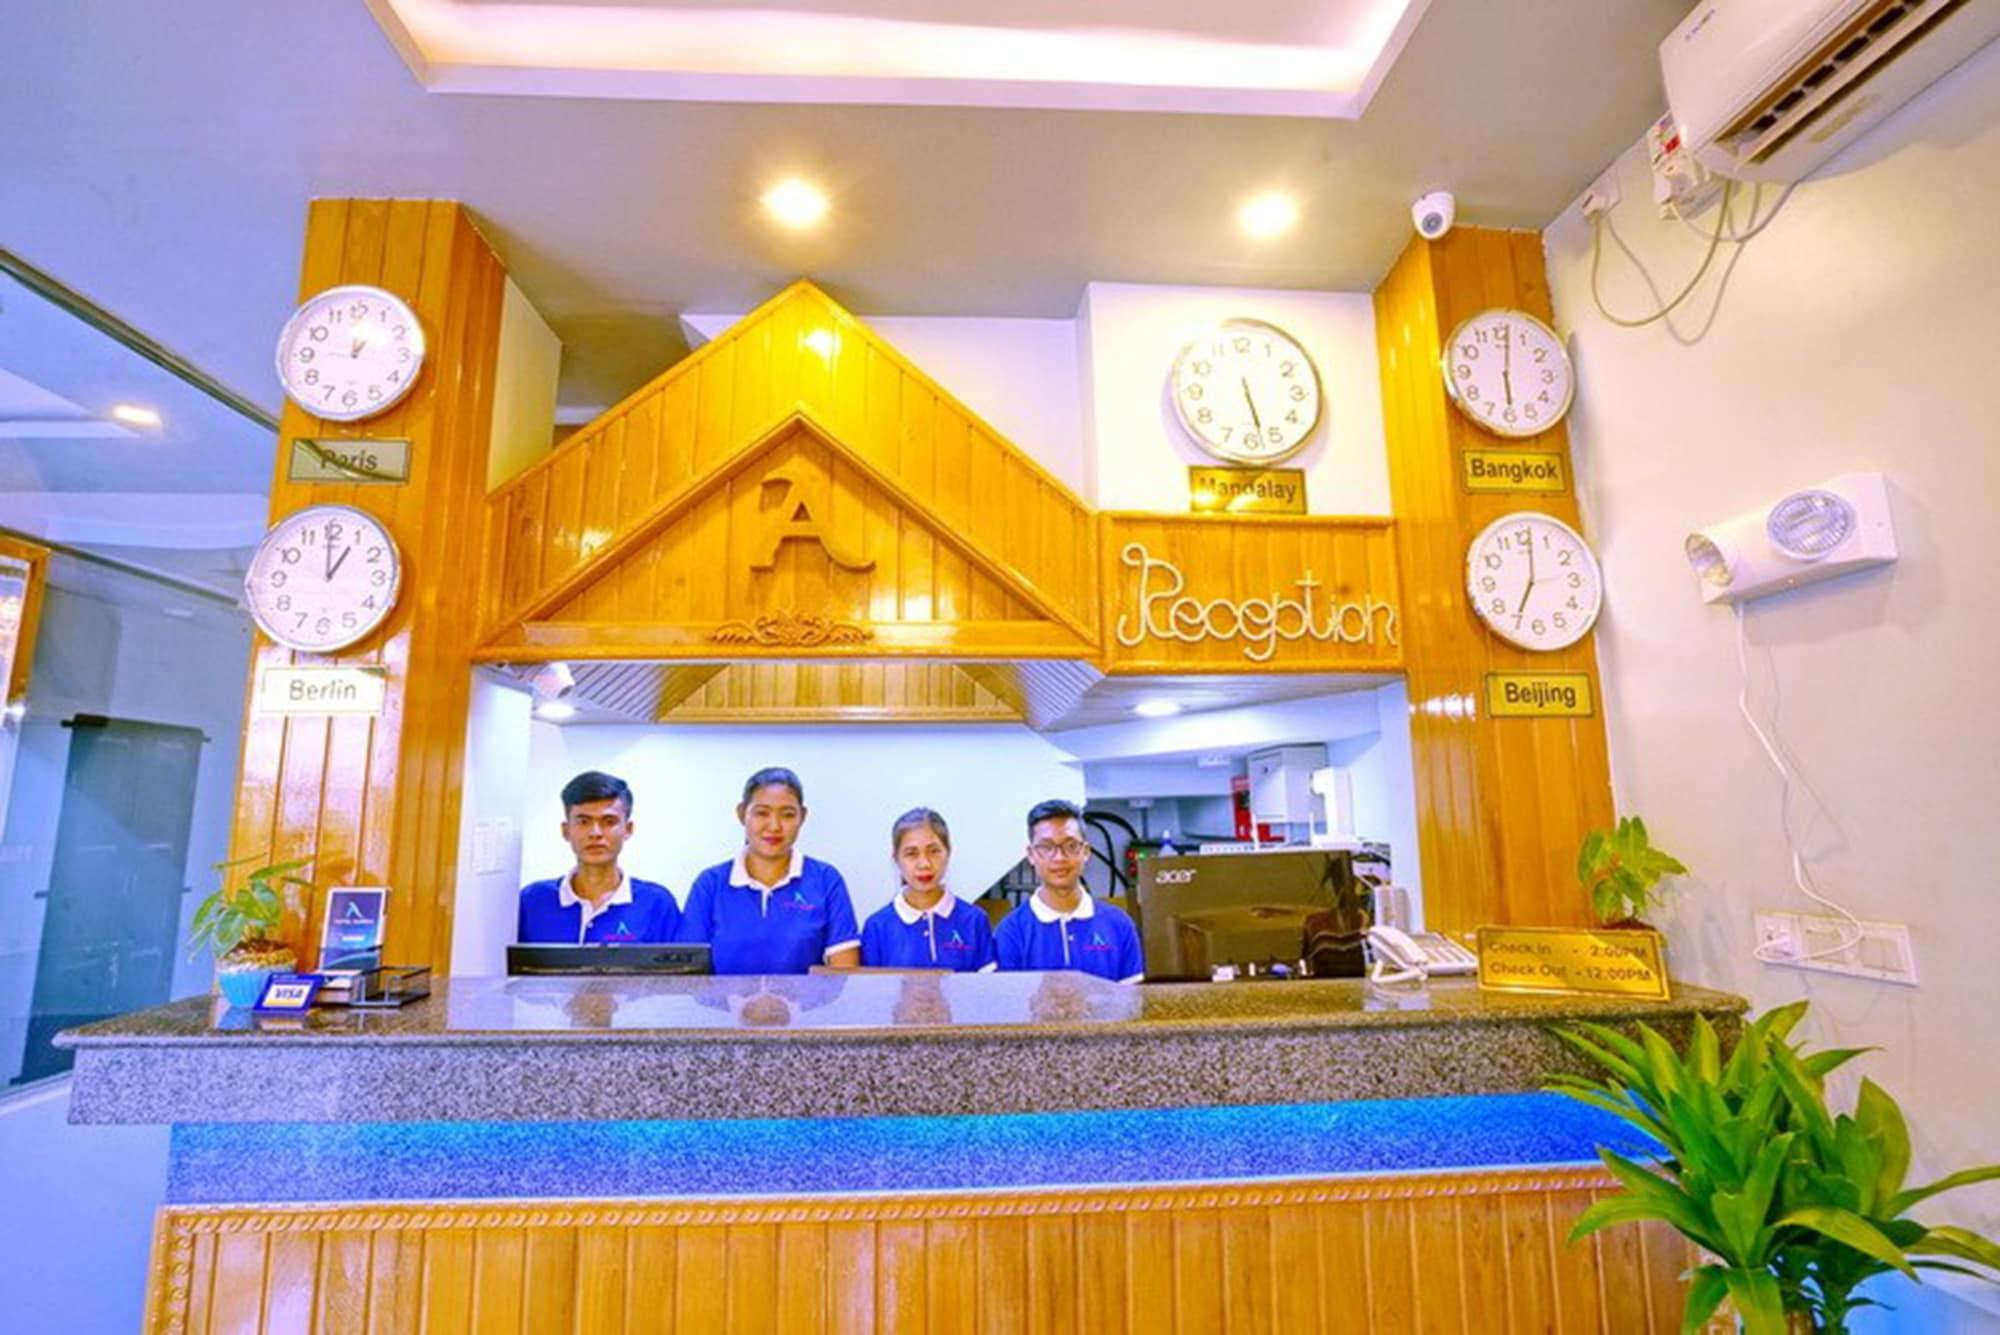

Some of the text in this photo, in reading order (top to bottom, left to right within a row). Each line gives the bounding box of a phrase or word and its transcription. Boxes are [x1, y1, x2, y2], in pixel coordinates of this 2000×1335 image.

[329, 309, 342, 322] 11
[380, 310, 387, 321] 1
[309, 325, 329, 342] 10
[392, 324, 406, 340] 2
[1475, 330, 1488, 343] 11
[1520, 333, 1526, 346] 1
[1212, 343, 1224, 356] 11
[1232, 337, 1250, 353] 12
[1265, 343, 1271, 357] 1
[1462, 344, 1479, 360] 10
[300, 347, 315, 363] 9
[398, 347, 410, 363] 3
[1534, 349, 1547, 363] 2
[386, 369, 400, 384] 4
[1192, 361, 1211, 376] 10
[1280, 361, 1295, 377] 2
[1457, 364, 1471, 380] 9
[304, 369, 319, 385] 8
[1541, 369, 1553, 385] 3
[322, 385, 335, 401] 7
[341, 390, 358, 407] 6
[367, 384, 382, 401] 5
[1188, 384, 1203, 400] 9
[1290, 385, 1305, 401] 3
[1466, 384, 1480, 401] 8
[1538, 390, 1549, 403] 4
[1198, 407, 1213, 424] 8
[1285, 409, 1298, 423] 4
[1484, 401, 1495, 416] 7
[1503, 407, 1517, 423] 6
[1523, 404, 1538, 419] 5
[1221, 427, 1233, 442] 7
[1243, 432, 1259, 449] 6
[1268, 427, 1283, 443] 5
[321, 448, 378, 471] Paris
[1471, 458, 1559, 483] Bangkok
[301, 529, 315, 545] 11
[355, 530, 361, 544] 1
[1497, 537, 1510, 550] 11
[1542, 536, 1549, 549] 1
[282, 547, 301, 564] 10
[367, 546, 381, 563] 2
[1484, 553, 1502, 569] 10
[1557, 550, 1570, 567] 2
[271, 570, 287, 588] 9
[370, 569, 386, 586] 3
[1482, 576, 1496, 592] 9
[1567, 572, 1581, 589] 3
[276, 594, 291, 611] 8
[361, 594, 375, 610] 4
[1117, 542, 1398, 661] Reception
[1492, 599, 1505, 614] 8
[1566, 595, 1578, 610] 4
[295, 612, 308, 628] 7
[315, 617, 331, 635] 6
[341, 612, 357, 628] 5
[1531, 618, 1546, 635] 6
[1552, 612, 1566, 628] 5
[289, 679, 357, 701] Berlin
[1505, 682, 1576, 708] Beijing
[1155, 869, 1197, 884] acer
[1489, 943, 1532, 954] Check
[1537, 943, 1552, 955] In
[1490, 962, 1534, 976] Check
[1540, 964, 1567, 978] Out
